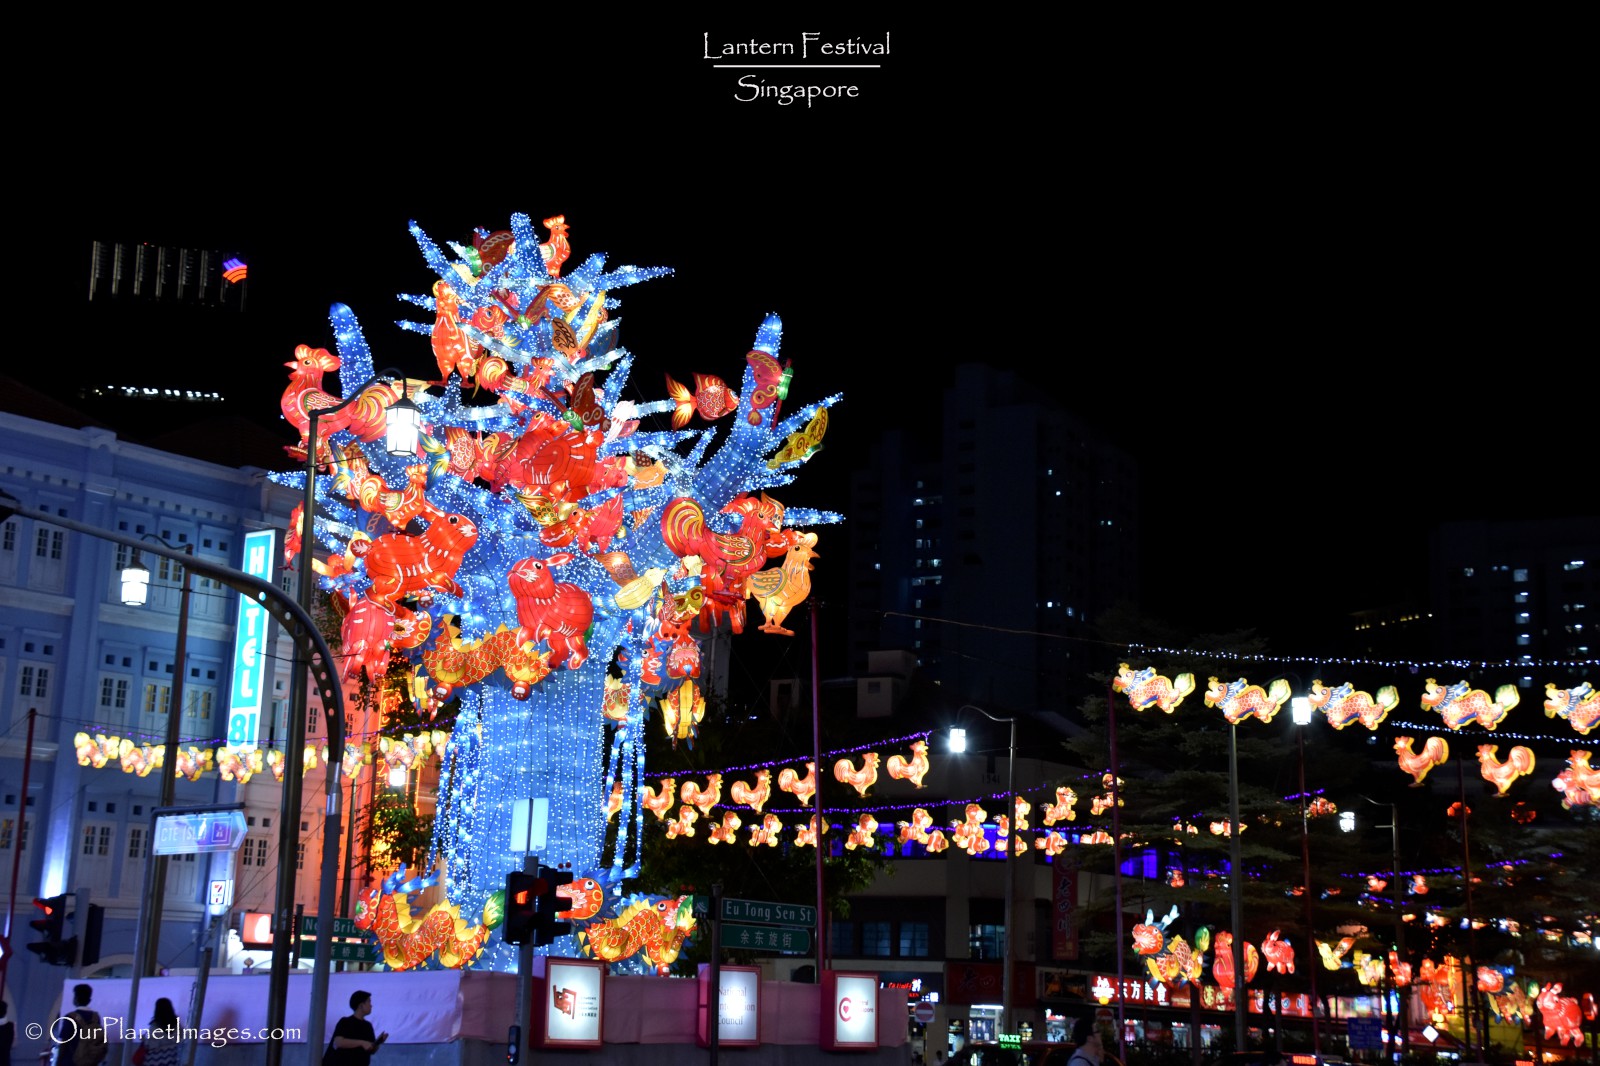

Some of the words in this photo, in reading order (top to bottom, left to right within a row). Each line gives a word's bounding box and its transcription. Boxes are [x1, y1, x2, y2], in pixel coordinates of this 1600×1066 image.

[229, 713, 257, 746] 81
[726, 900, 739, 915] Eu
[744, 902, 771, 921] Tong
[775, 905, 796, 921] Sen
[800, 907, 811, 922] St
[740, 929, 793, 948] 余东旋街
[998, 1033, 1021, 1043] TAXI
